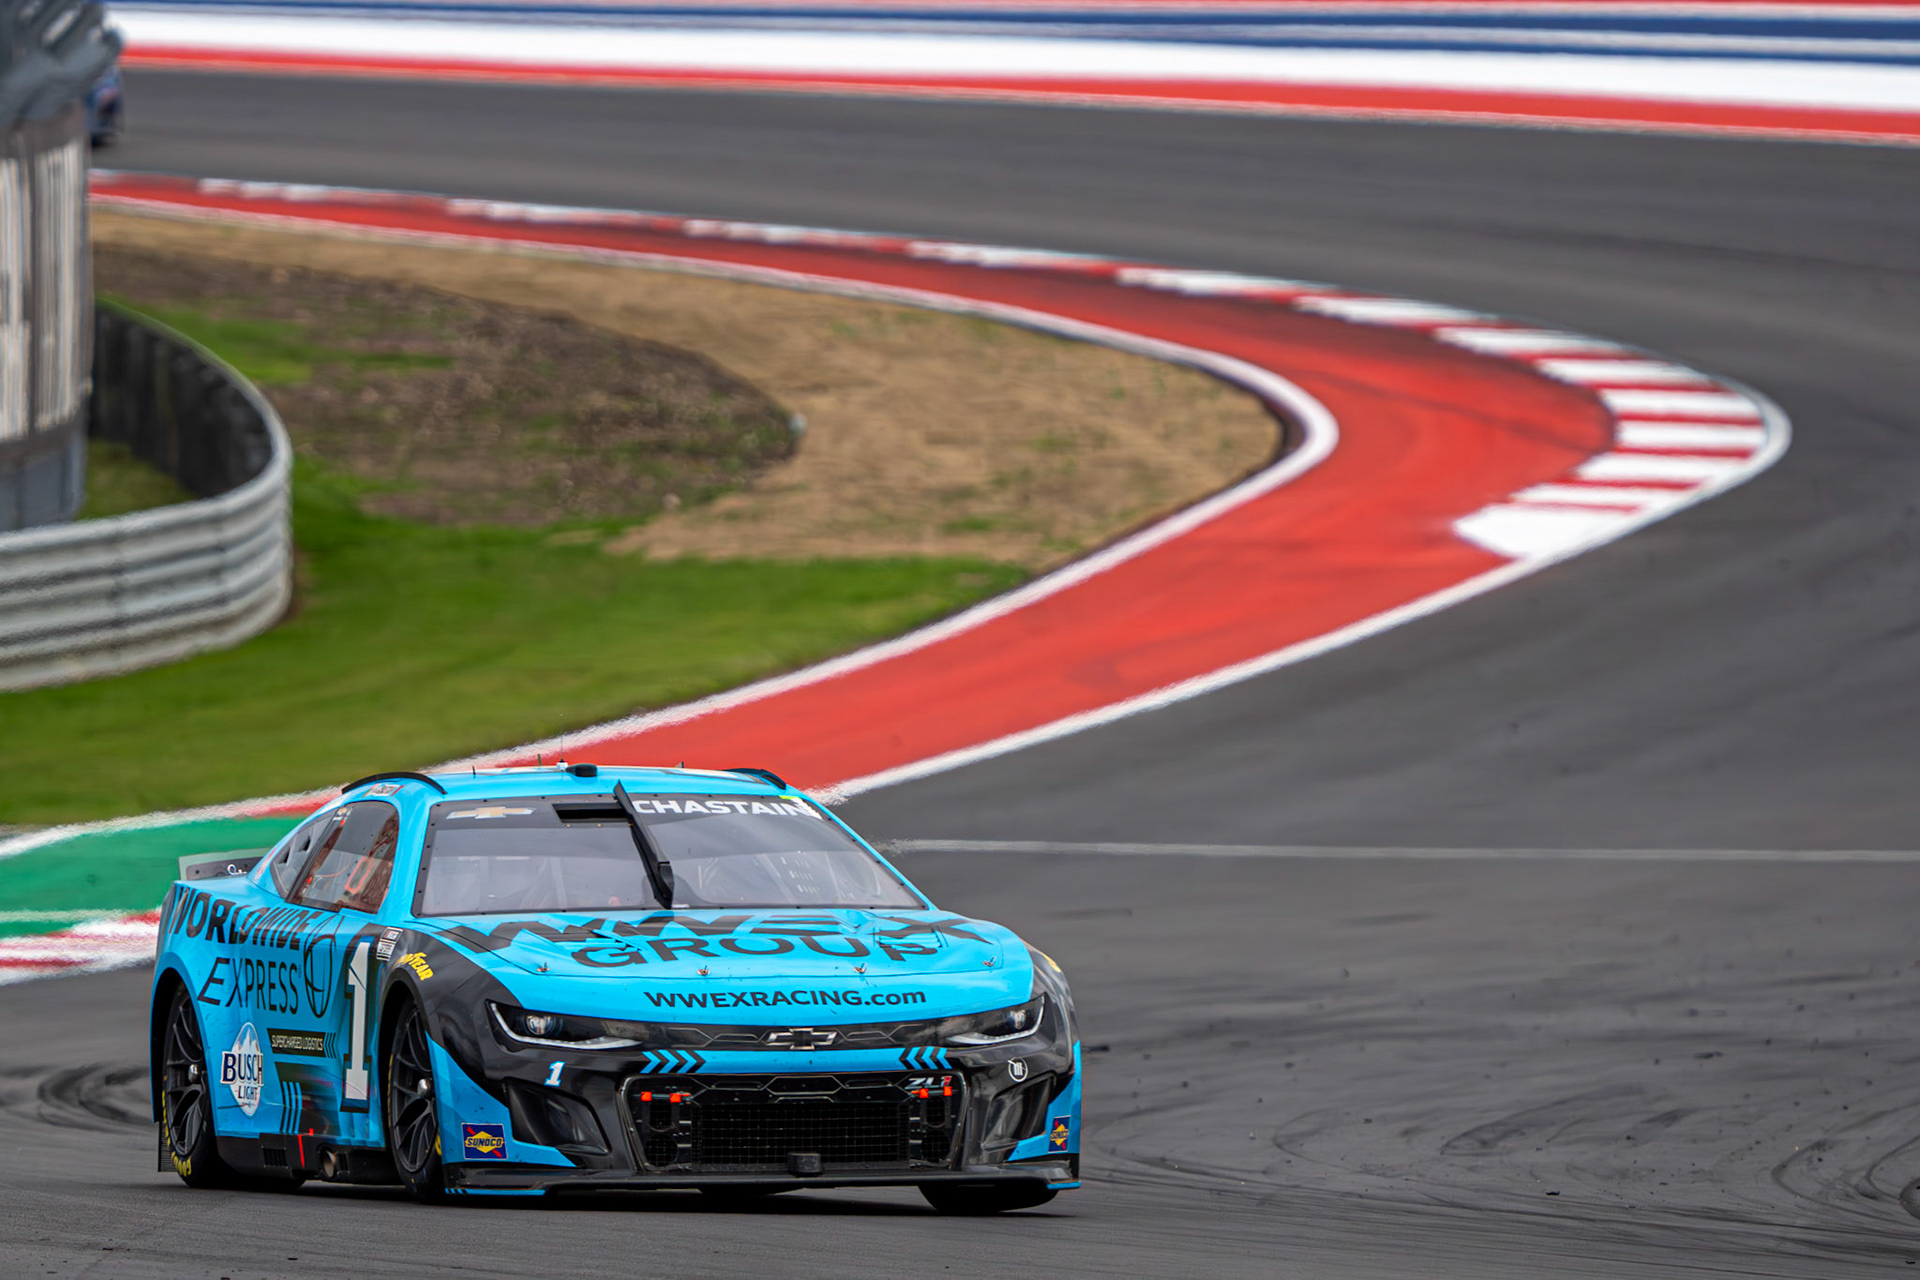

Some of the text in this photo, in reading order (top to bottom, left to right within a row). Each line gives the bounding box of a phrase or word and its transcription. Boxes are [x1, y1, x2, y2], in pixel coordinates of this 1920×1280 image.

[632, 799, 809, 817] CHASTAIN
[168, 886, 324, 950] WORLDWIDE
[433, 912, 993, 953] WWEX
[571, 936, 939, 968] GROUP
[197, 957, 299, 1015] EXPRESS
[644, 990, 926, 1008] WWEXRACING.com
[343, 938, 372, 1106] 1
[222, 1053, 263, 1085] BUSCH
[544, 1061, 565, 1086] 1
[904, 1075, 953, 1089] ZL1
[237, 1085, 258, 1100] LIGHT
[467, 1137, 503, 1147] SUNOCO
